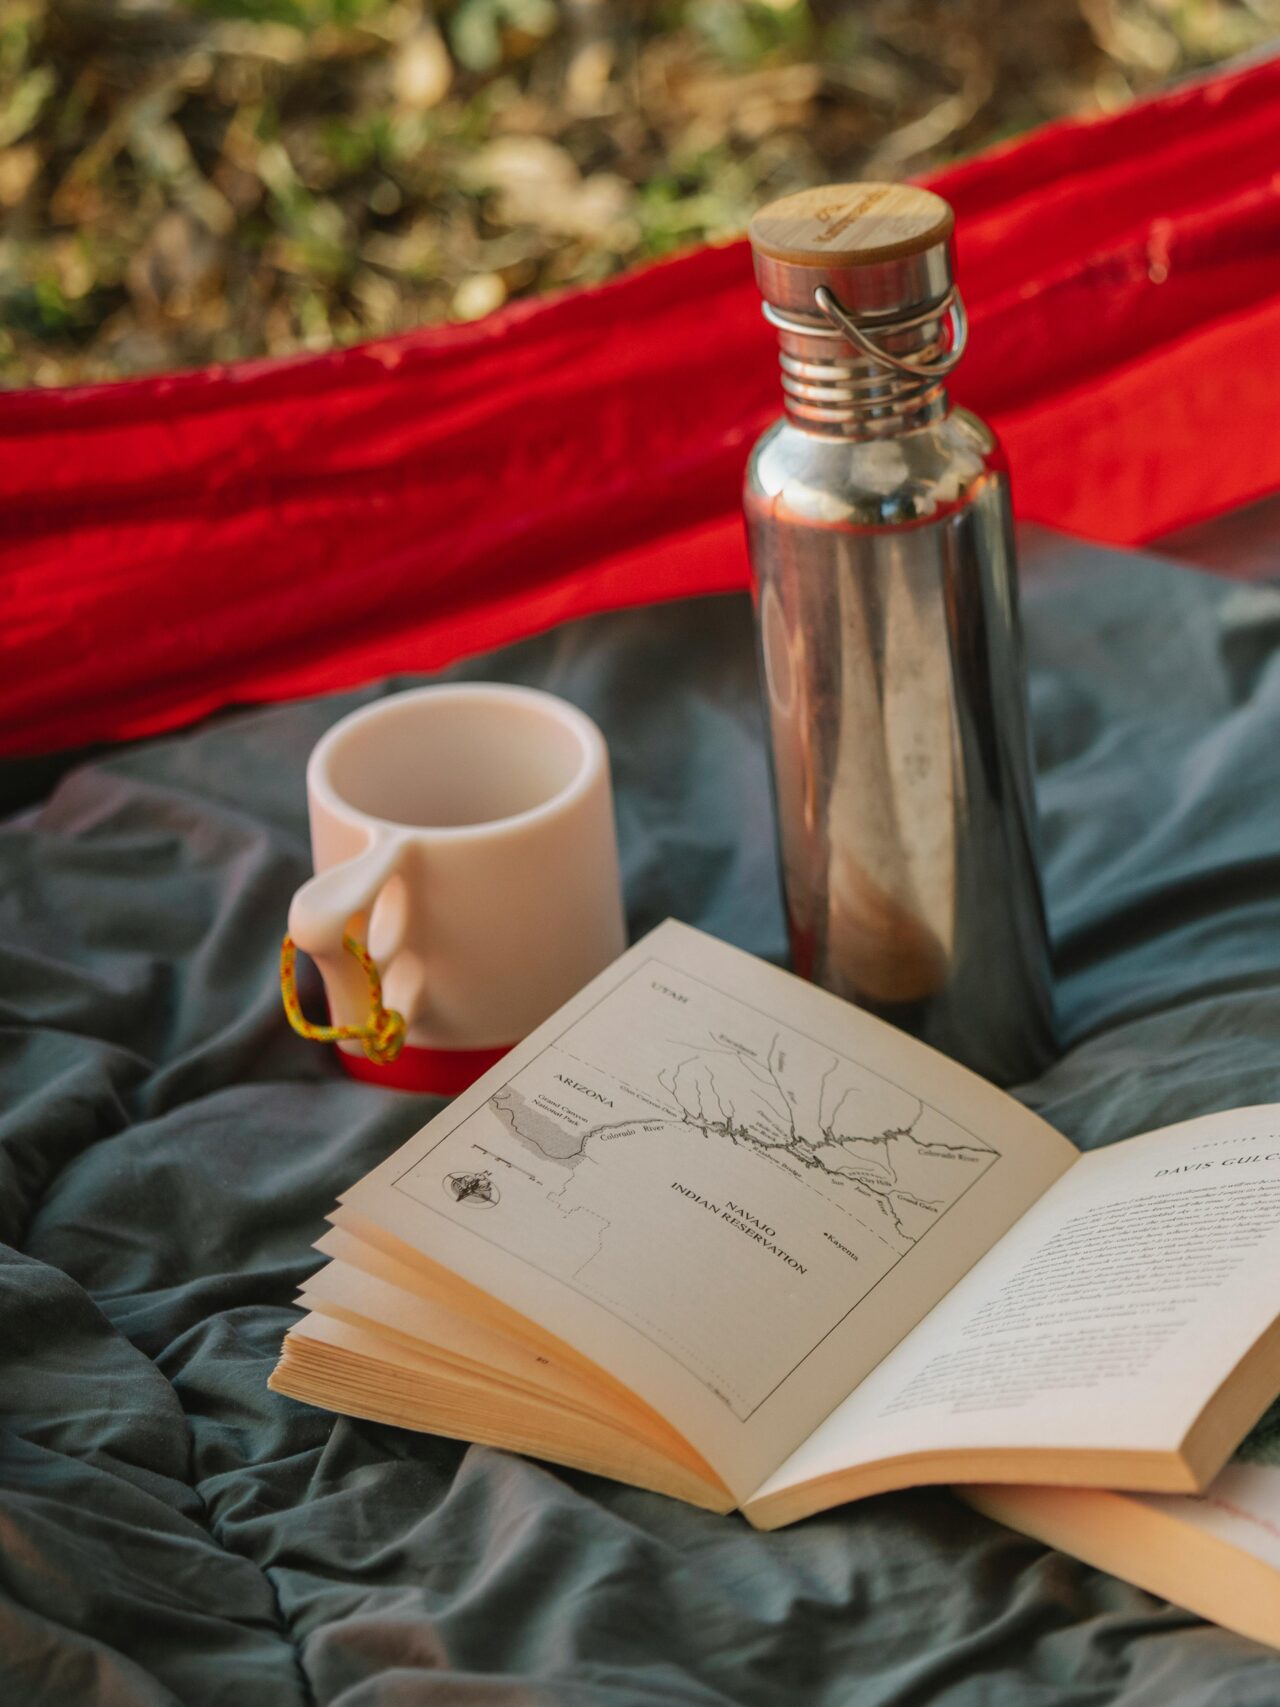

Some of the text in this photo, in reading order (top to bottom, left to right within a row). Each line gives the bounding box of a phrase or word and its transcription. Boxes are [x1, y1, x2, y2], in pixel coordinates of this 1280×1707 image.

[651, 981, 689, 1004] UTAH
[553, 1073, 615, 1109] ARIZONA
[531, 1099, 579, 1127] National Park
[538, 1094, 589, 1124] Grand Canyon
[600, 1125, 665, 1142] Colorado River
[1153, 1160, 1215, 1178] DAVIS
[671, 1181, 808, 1275] INDIAN RESERVATION
[725, 1201, 777, 1238] NAVAJO
[826, 1233, 860, 1262] Kayenta
